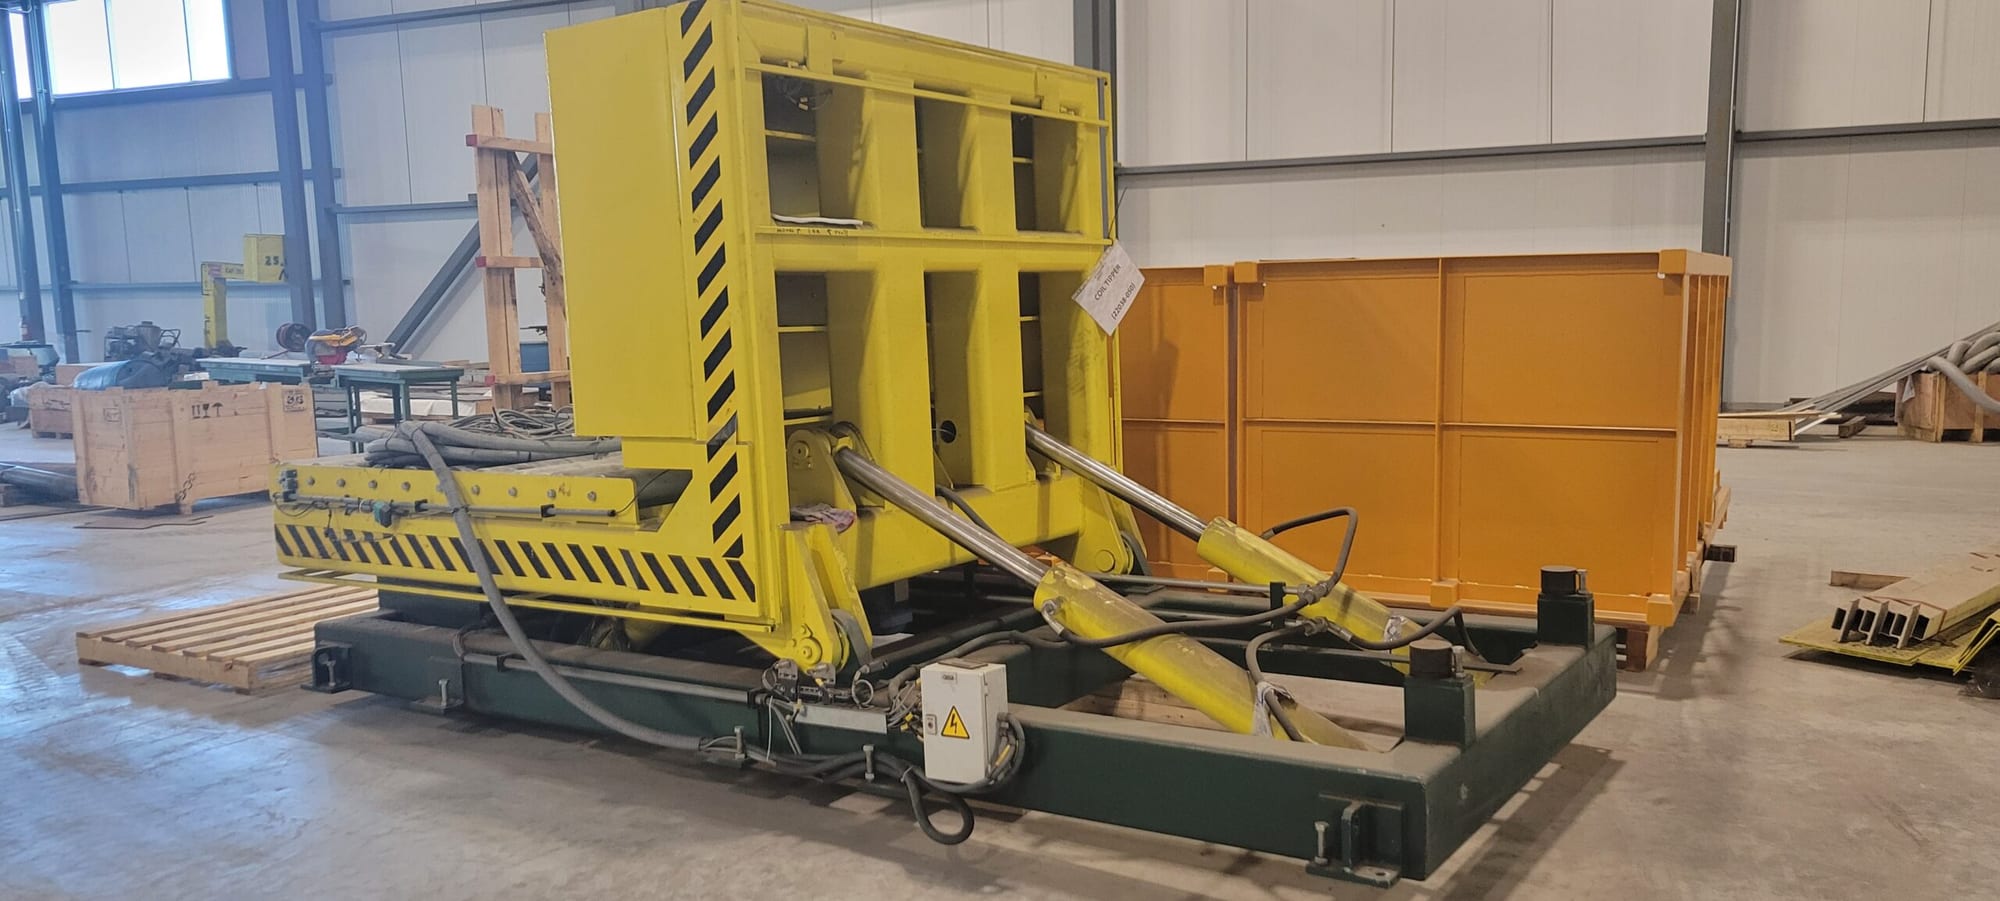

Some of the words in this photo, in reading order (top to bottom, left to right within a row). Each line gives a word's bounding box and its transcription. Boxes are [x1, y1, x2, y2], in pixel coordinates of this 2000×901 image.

[264, 255, 286, 266] 25.
[1095, 287, 1107, 301] COIL
[1105, 263, 1121, 286] TIPPER
